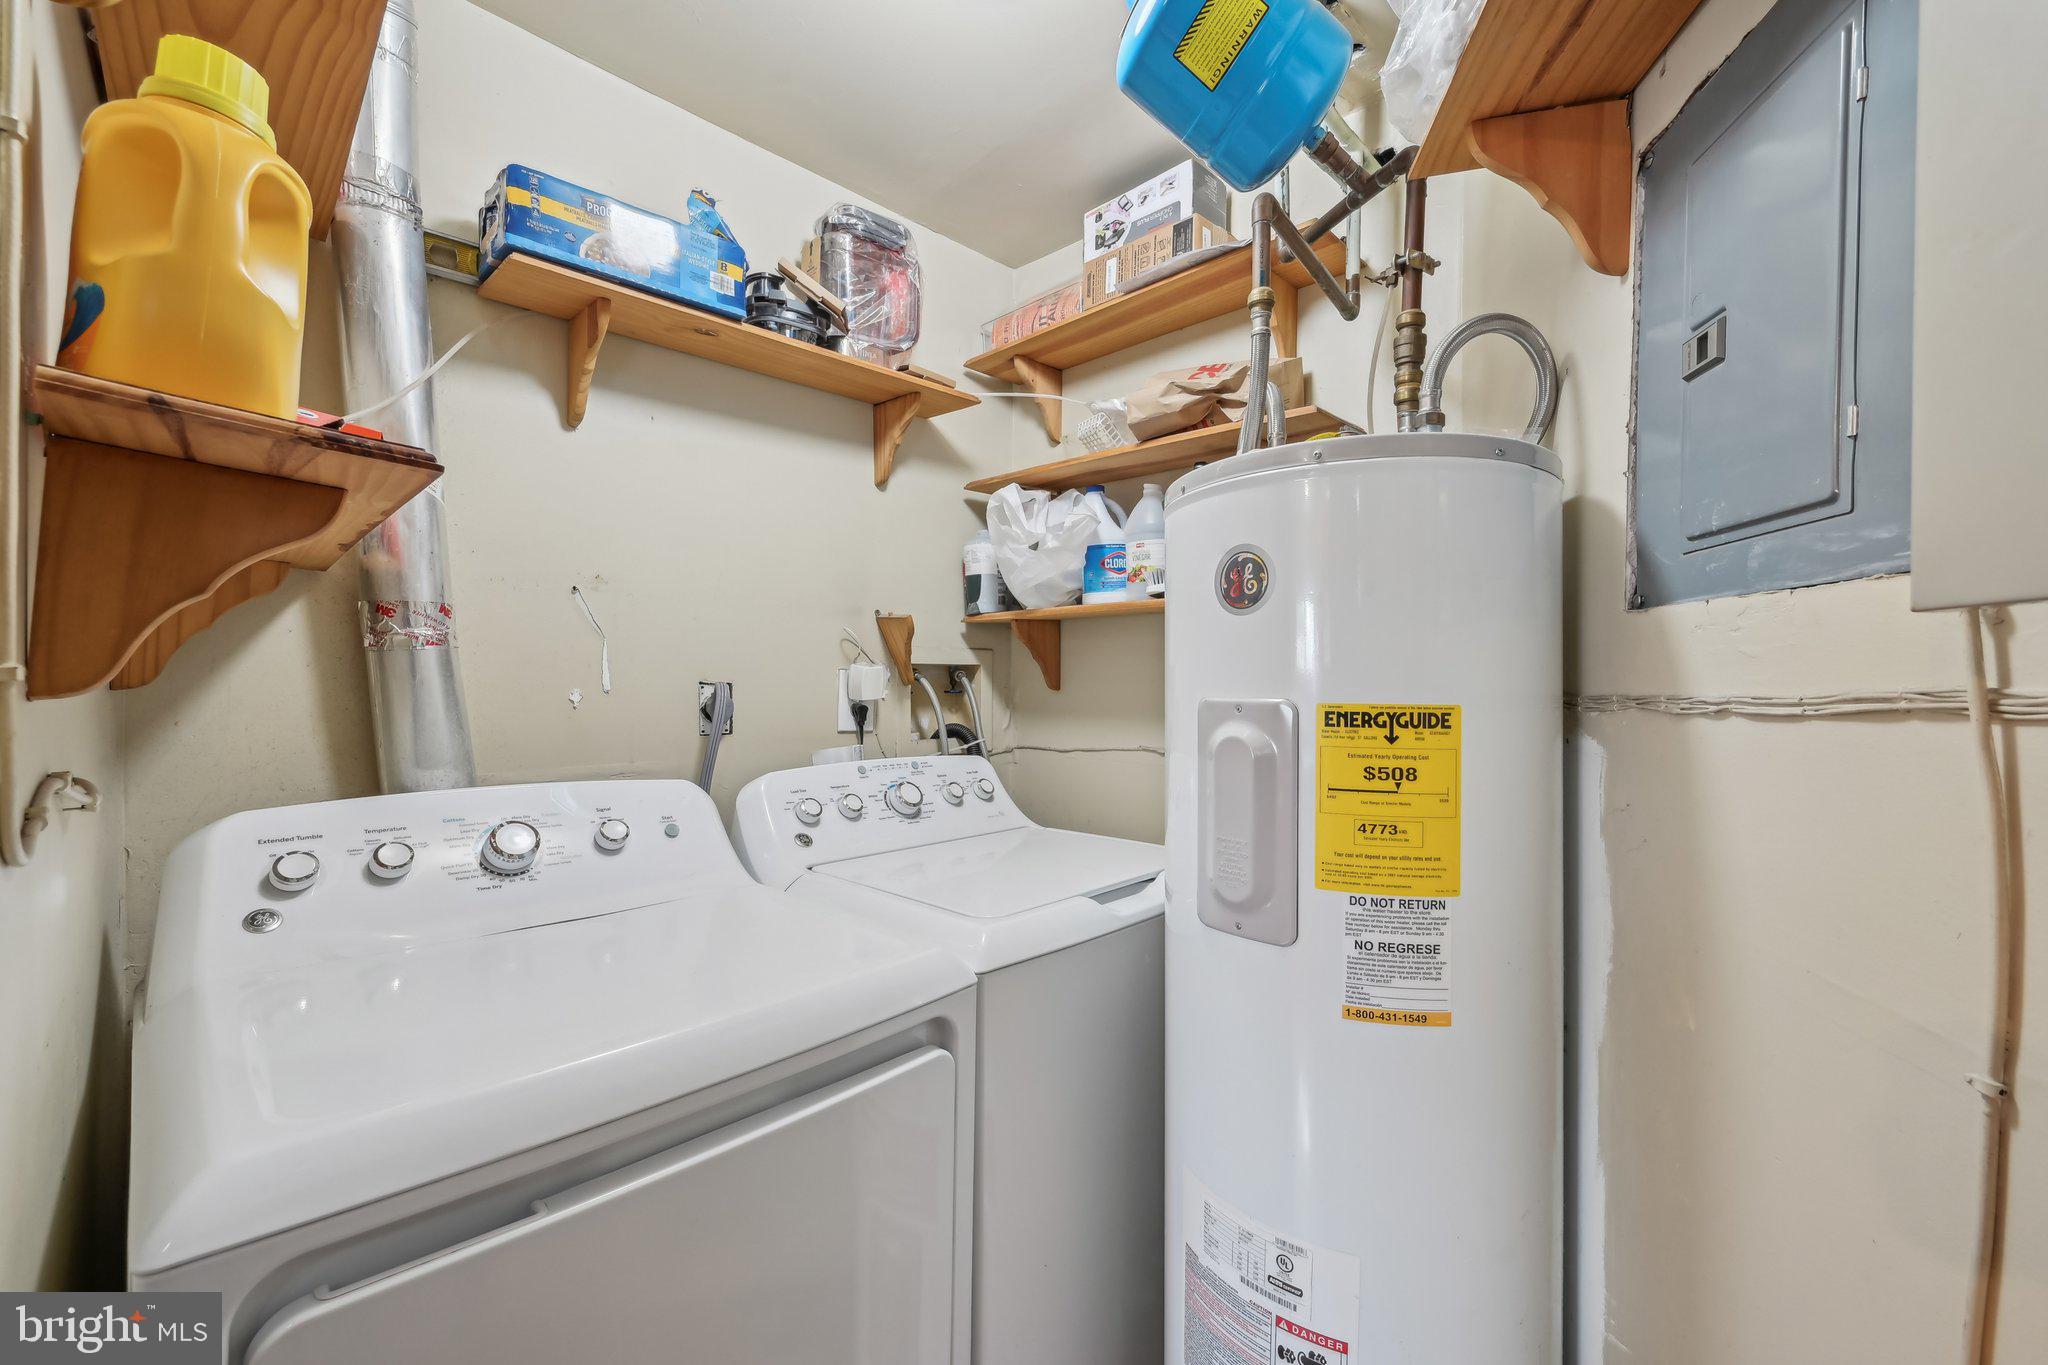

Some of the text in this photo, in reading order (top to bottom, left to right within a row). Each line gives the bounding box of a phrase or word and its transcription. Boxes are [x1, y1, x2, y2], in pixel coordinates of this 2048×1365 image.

[1209, 8, 1263, 83] WARNING!
[720, 263, 728, 271] 8
[1105, 558, 1126, 568] CLORO
[375, 603, 397, 618] 3M
[438, 602, 453, 619] 3M
[1324, 711, 1451, 731] ENERGYGUIDE
[1363, 766, 1418, 782] $508
[364, 826, 407, 834] Temperature
[1357, 823, 1398, 835] 4773
[258, 833, 324, 846] Extended Tumble
[1349, 896, 1446, 910] DO NOT RETURN
[1354, 940, 1440, 955] NO REGRESE
[1345, 1008, 1427, 1023] 1-800-431-1549
[1280, 1257, 1290, 1270] UL
[1291, 1325, 1343, 1351] DANGER
